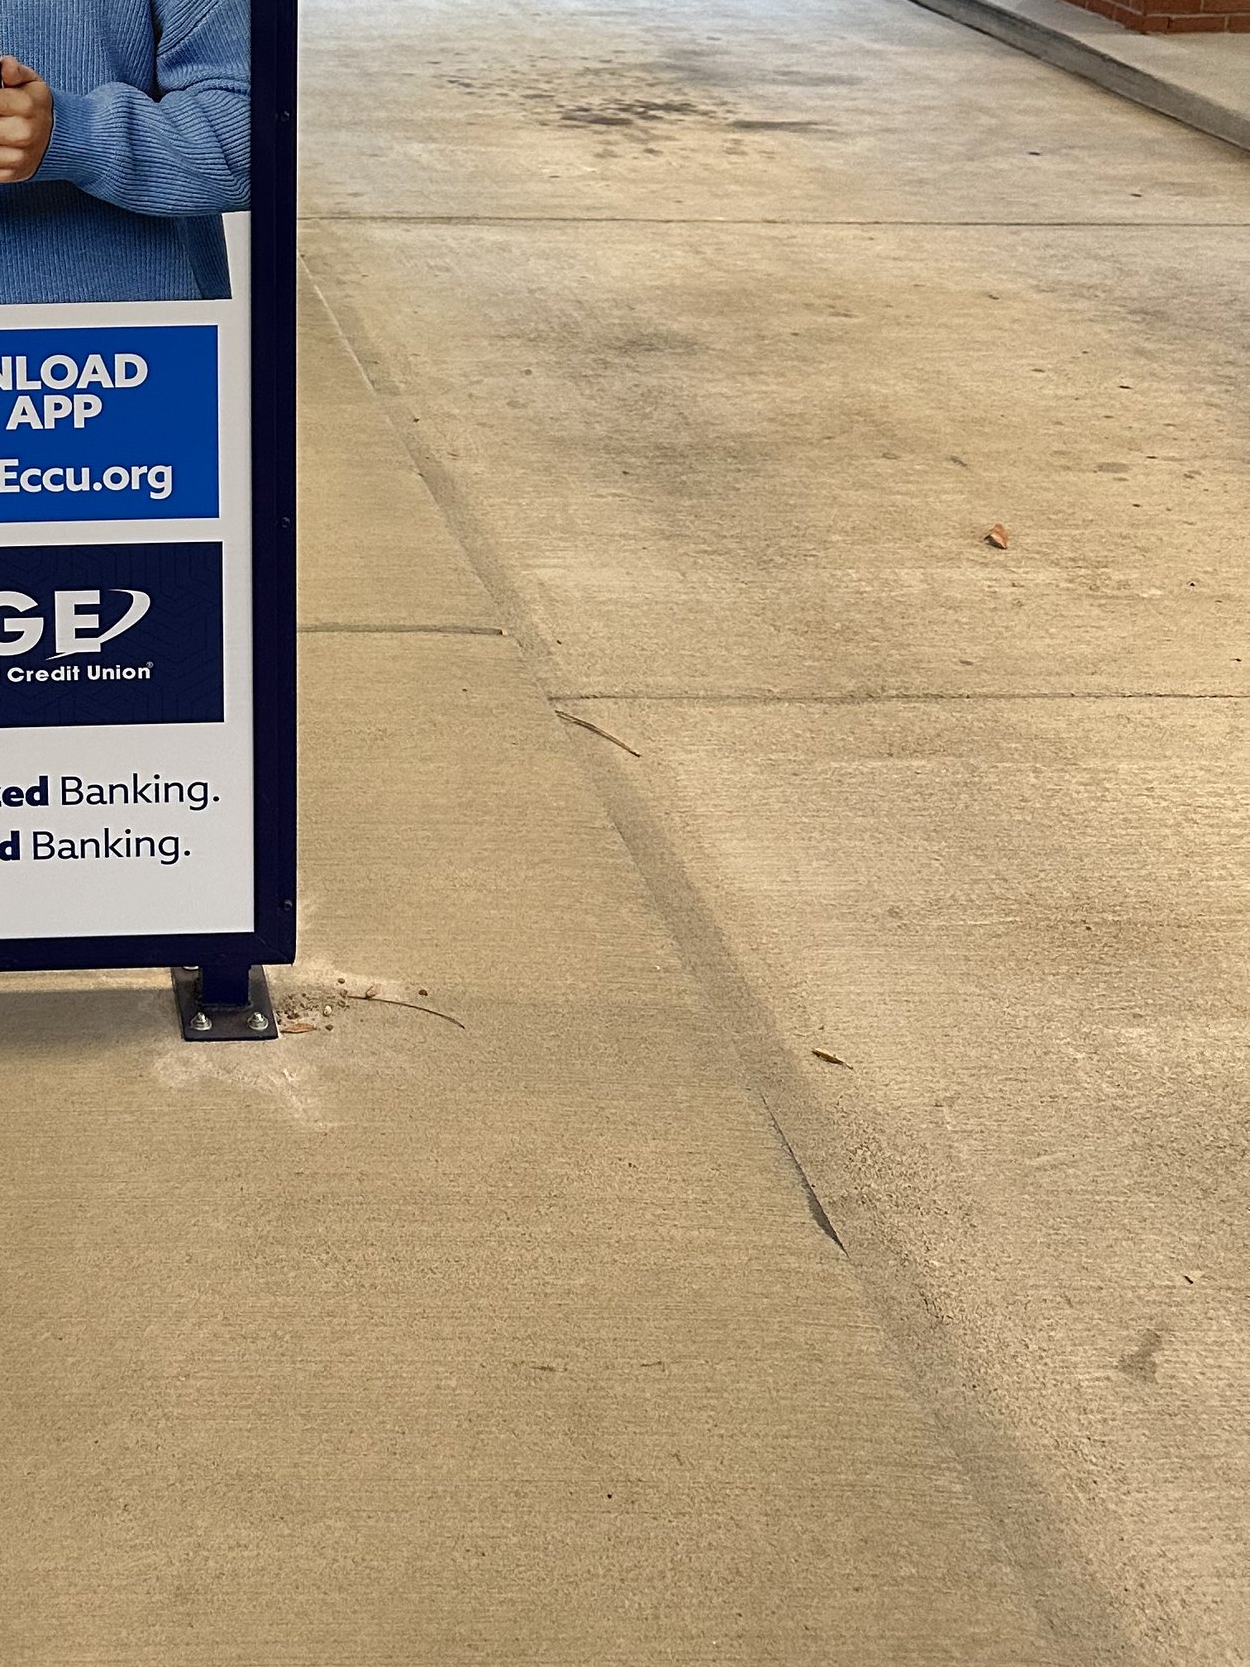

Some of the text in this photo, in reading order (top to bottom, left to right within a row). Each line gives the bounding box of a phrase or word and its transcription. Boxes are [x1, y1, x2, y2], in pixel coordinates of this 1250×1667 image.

[6, 394, 103, 431] APP
[6, 665, 80, 683] Credit
[61, 772, 220, 810] Banking.
[32, 827, 191, 866] Banking.
